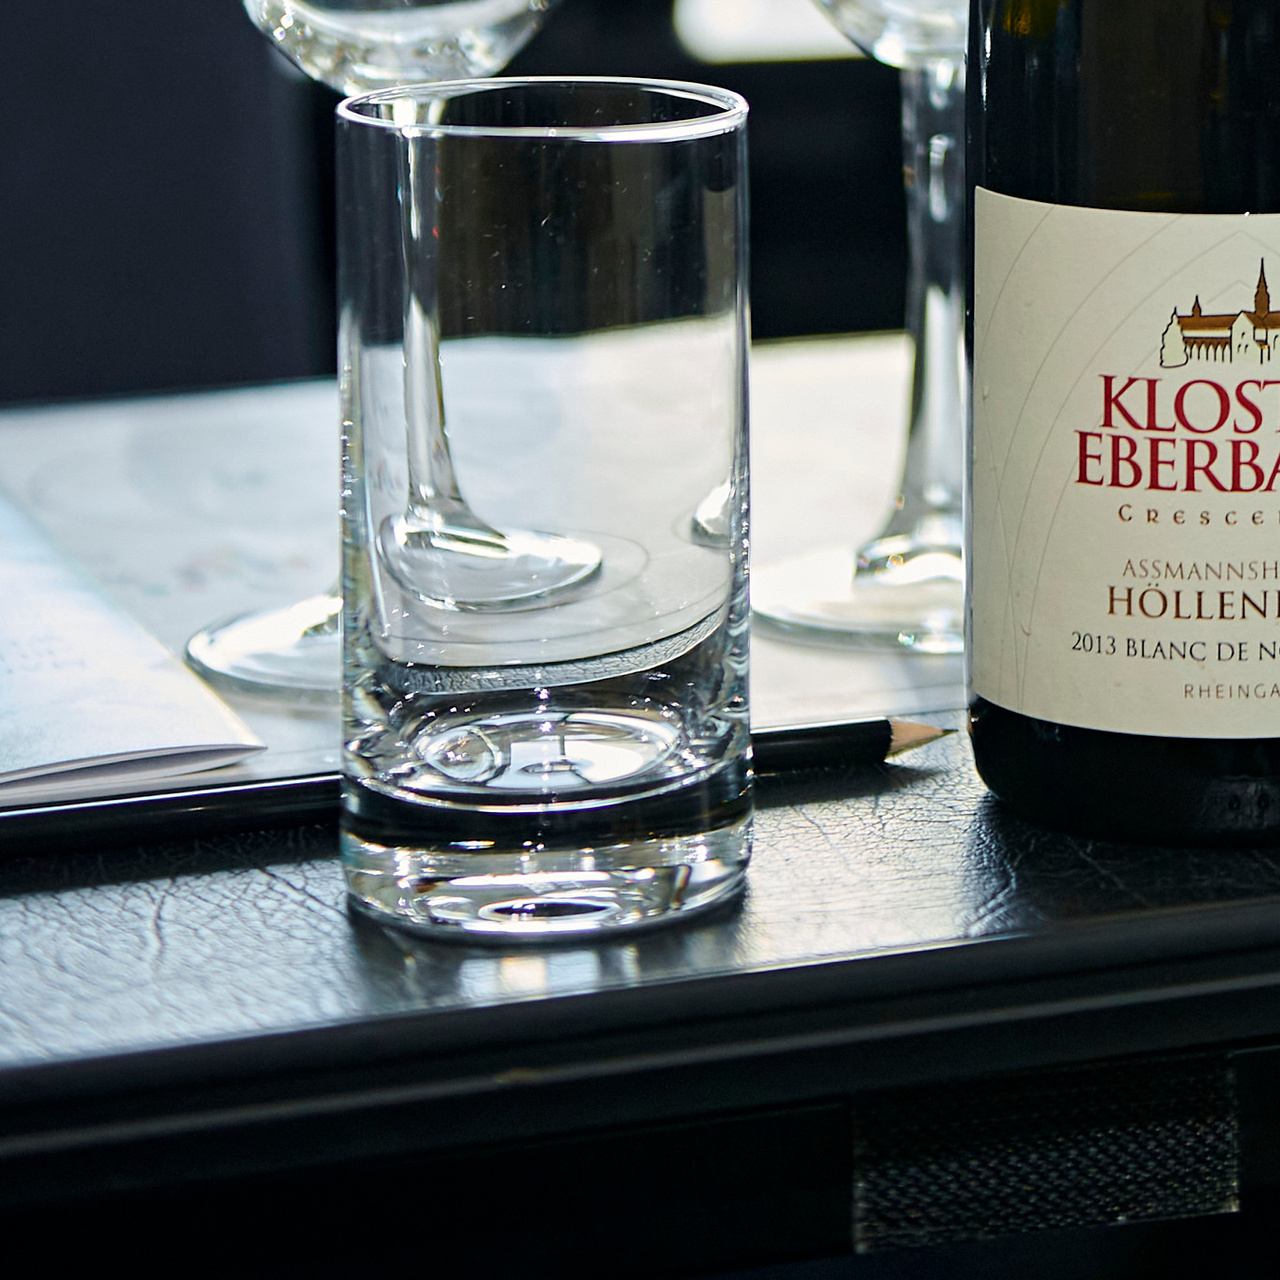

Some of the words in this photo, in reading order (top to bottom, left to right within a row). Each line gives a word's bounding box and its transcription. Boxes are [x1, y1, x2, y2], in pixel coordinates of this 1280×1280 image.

[1071, 631, 1117, 656] 2013
[1126, 637, 1207, 662] BLANC
[1216, 641, 1248, 662] DE
